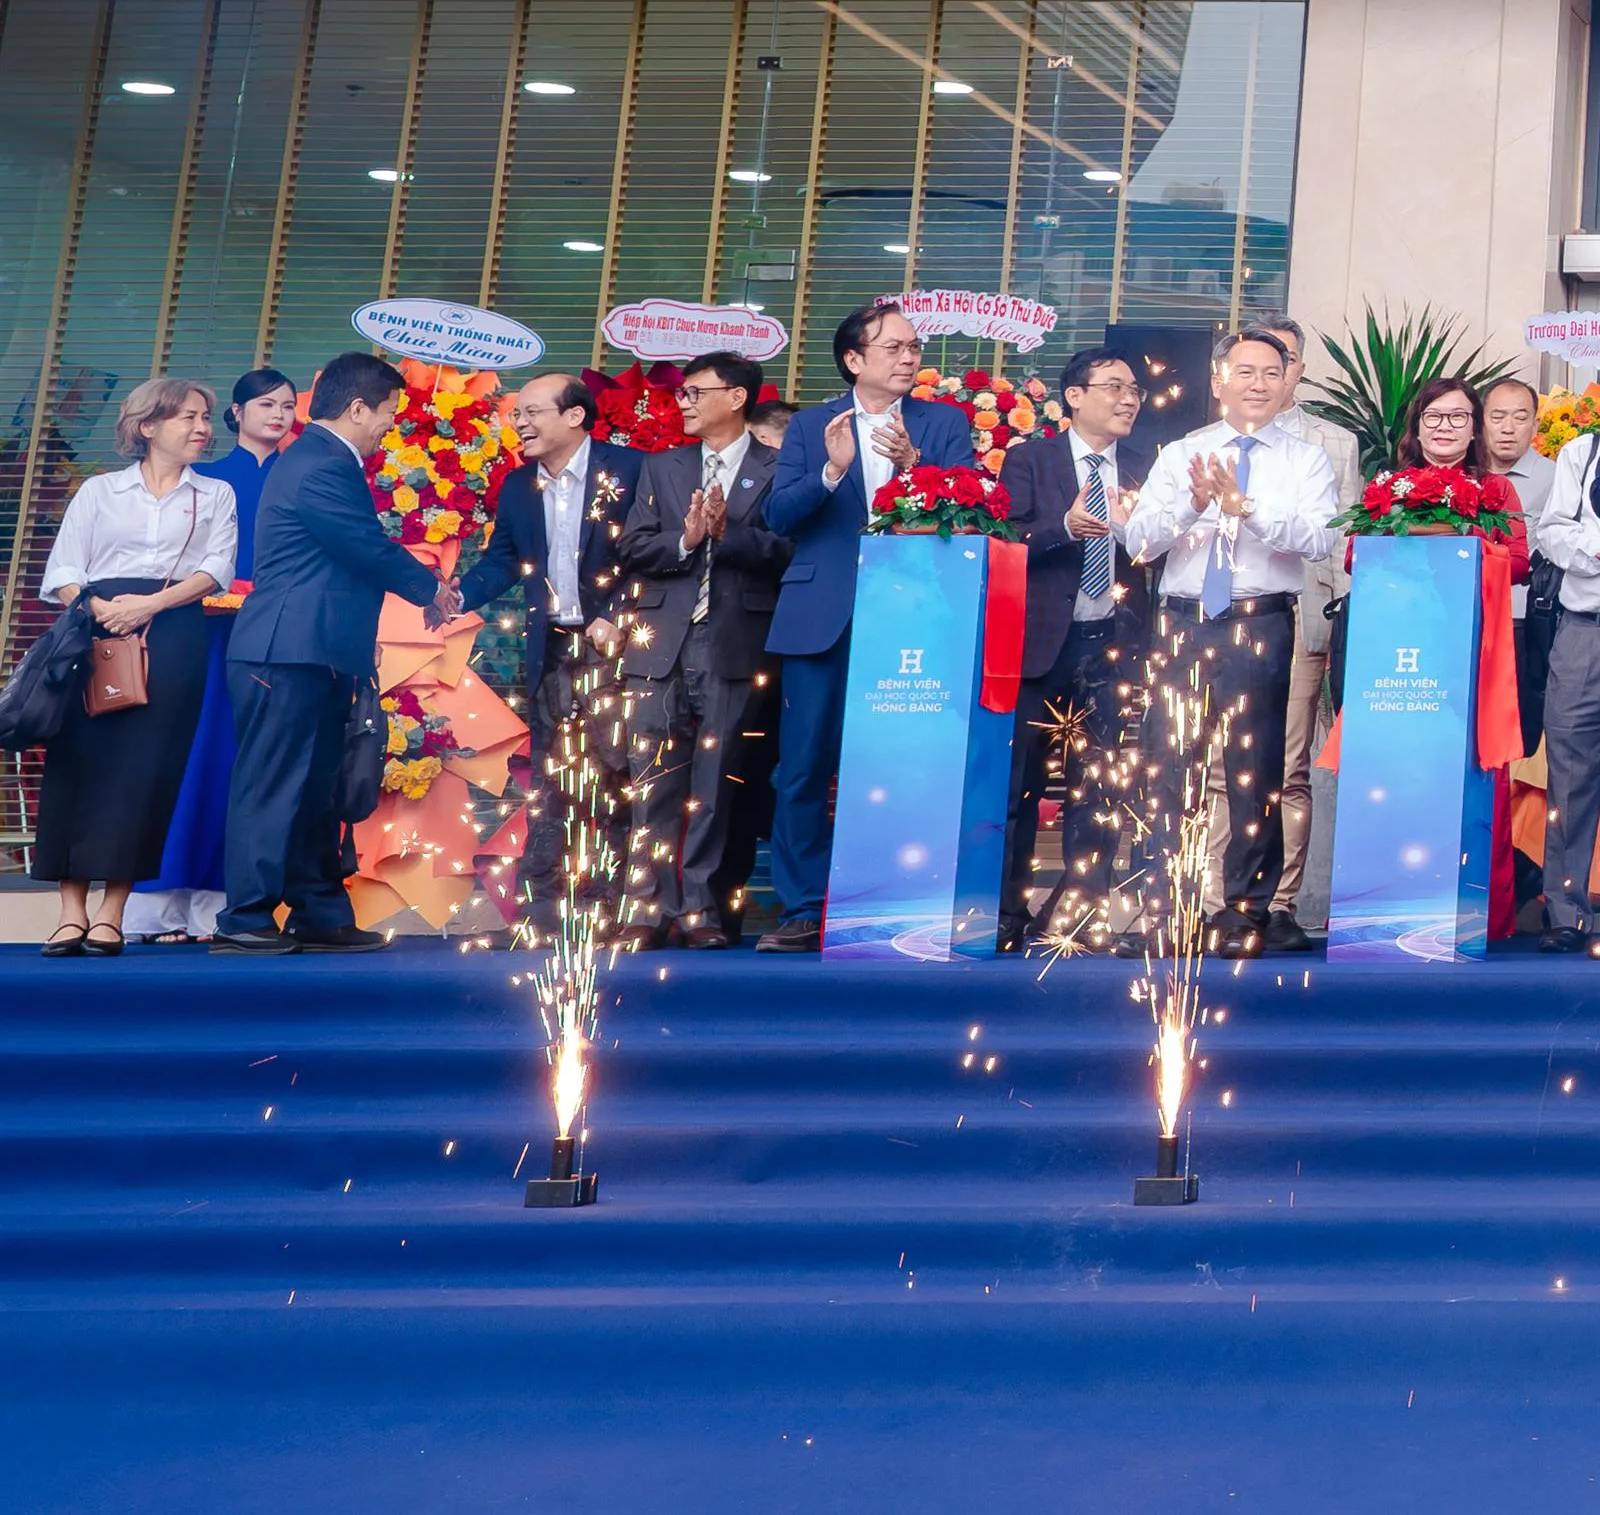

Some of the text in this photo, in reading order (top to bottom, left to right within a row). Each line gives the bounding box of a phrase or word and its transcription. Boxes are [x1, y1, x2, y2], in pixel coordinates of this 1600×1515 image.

[902, 291, 932, 313] Hiểm
[936, 292, 950, 312] Xã
[954, 292, 974, 317] Hội
[1010, 299, 1033, 323] Thủ
[1033, 305, 1056, 329] Đức
[368, 311, 533, 351] BỆNH VIỆN THỐNG NHẤT
[1528, 321, 1566, 340] Trường
[1570, 320, 1587, 340] Đại
[383, 328, 508, 364] Chúc Mừng
[898, 649, 924, 674] H
[1395, 648, 1420, 673] H
